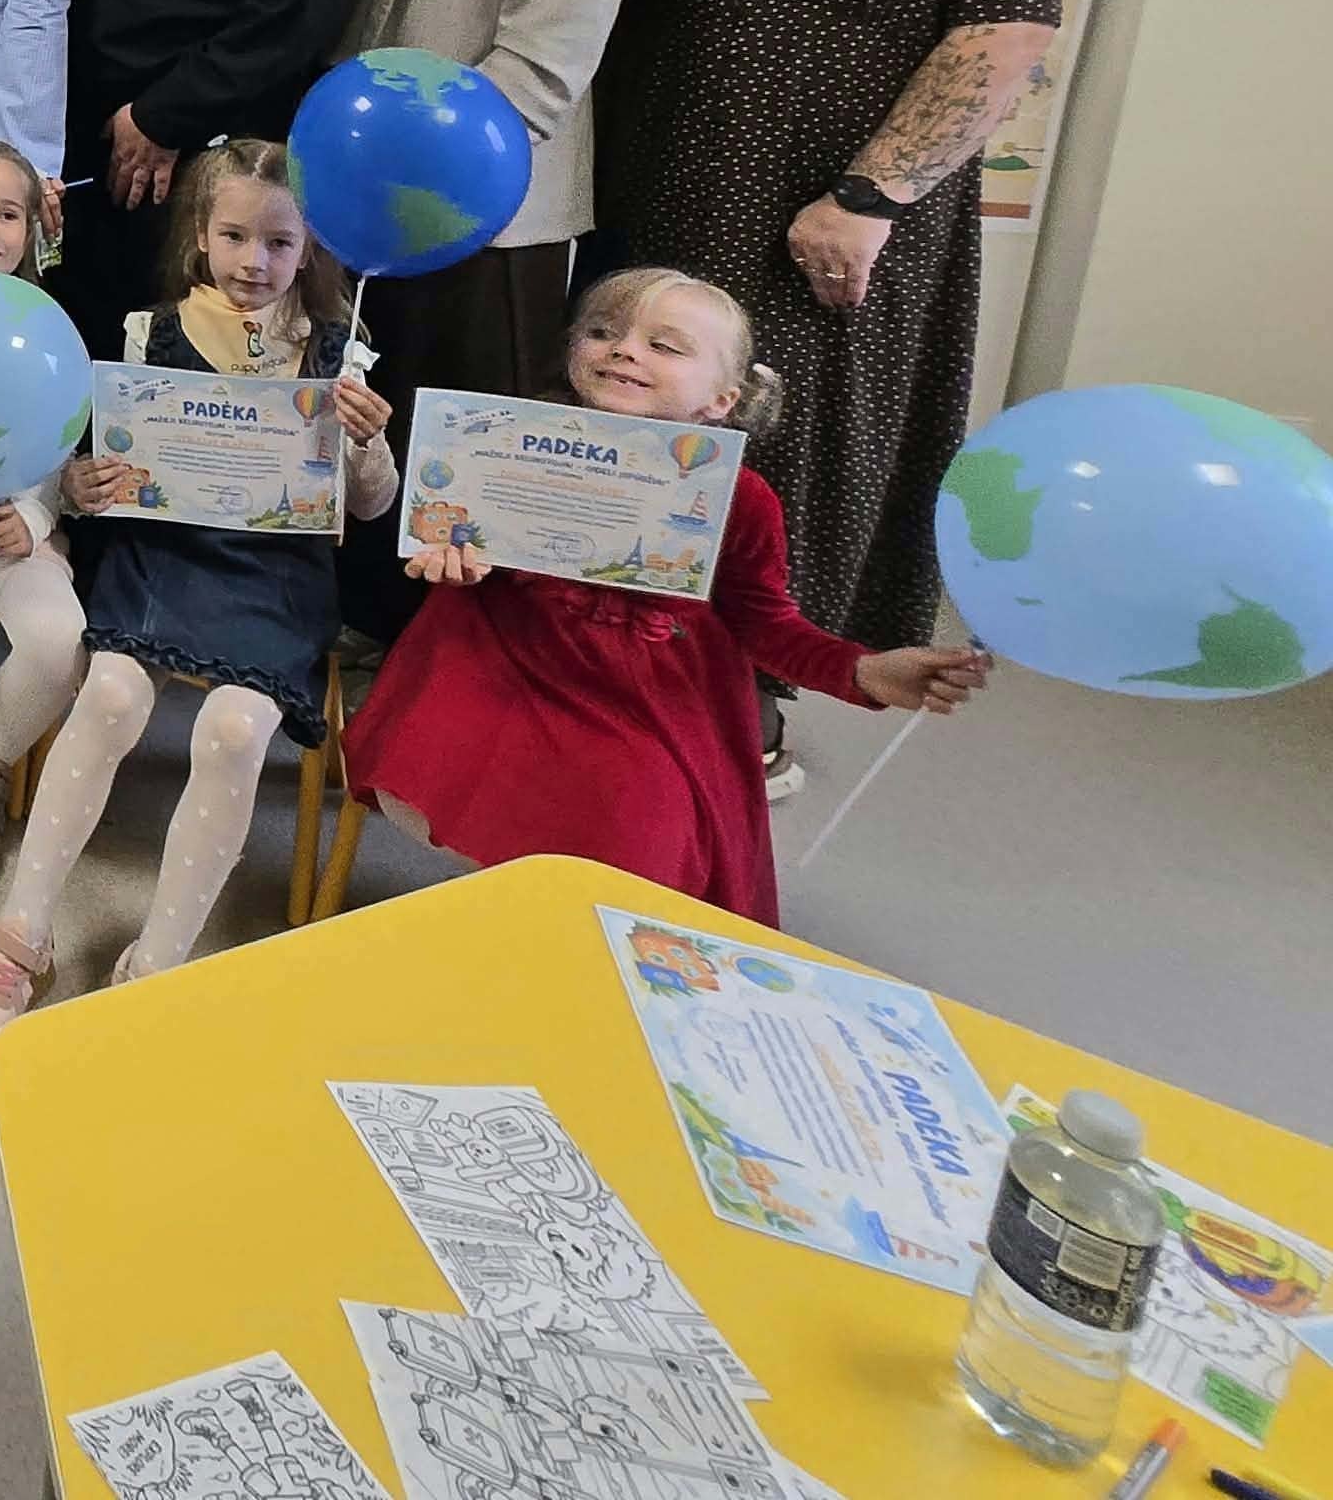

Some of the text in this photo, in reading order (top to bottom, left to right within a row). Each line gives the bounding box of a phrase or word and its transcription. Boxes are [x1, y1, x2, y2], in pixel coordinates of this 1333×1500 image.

[183, 400, 258, 422] PADĖKA
[521, 434, 619, 466] PADĖKA
[883, 1070, 973, 1177] PADĖKA
